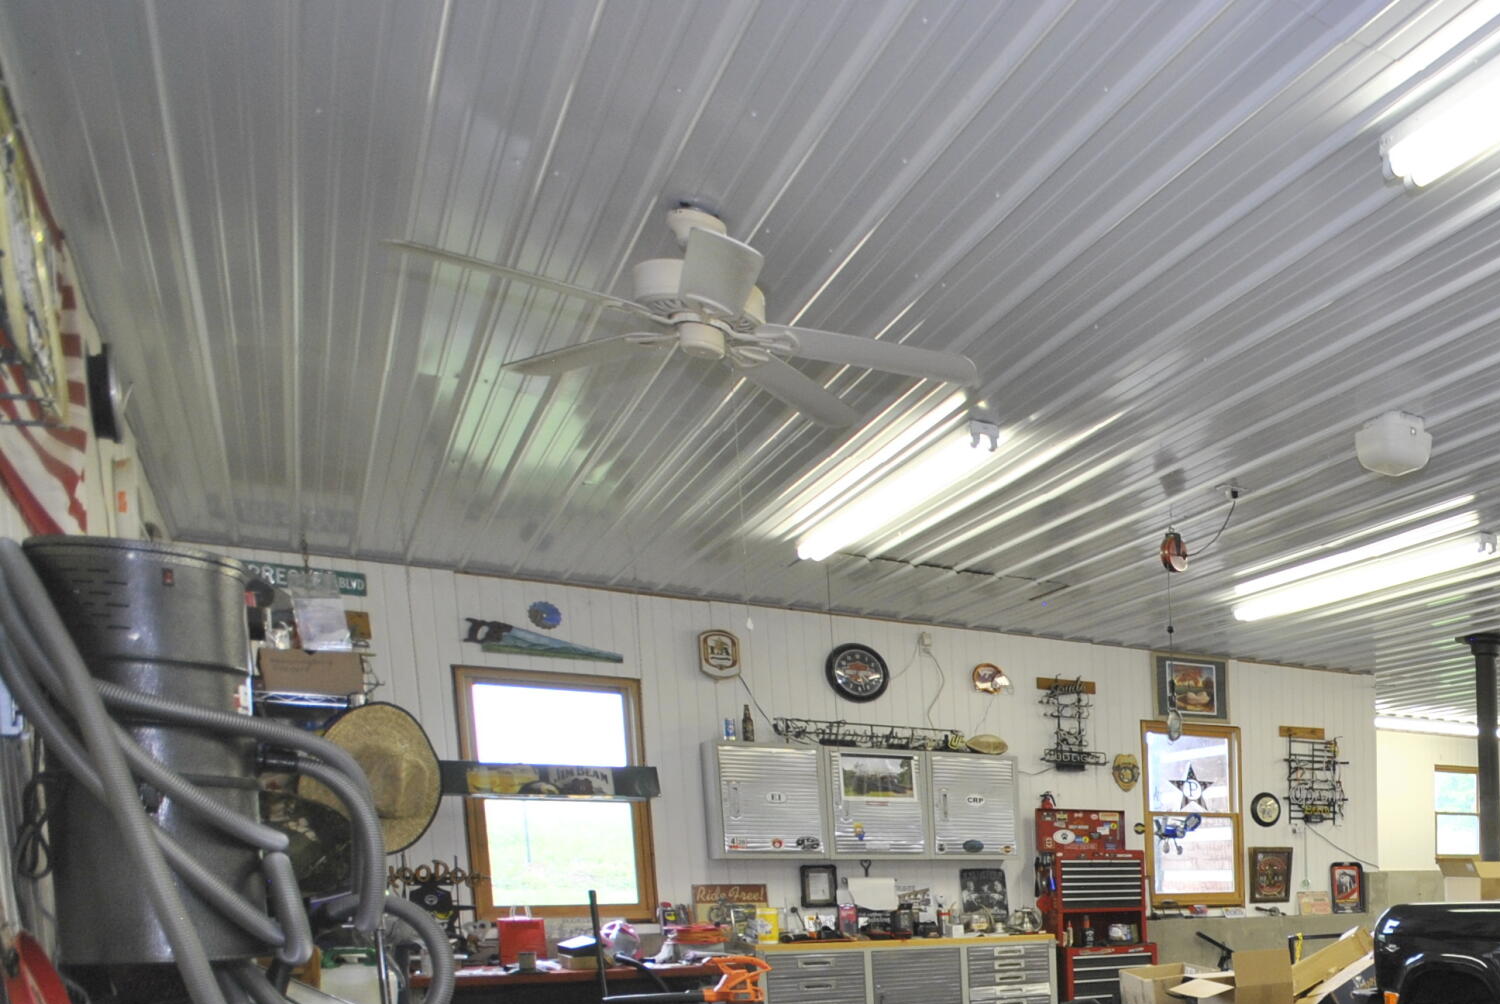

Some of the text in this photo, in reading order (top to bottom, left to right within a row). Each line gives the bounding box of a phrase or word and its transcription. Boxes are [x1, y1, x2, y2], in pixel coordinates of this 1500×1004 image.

[339, 577, 365, 590] BLVD
[554, 766, 609, 784] JIM BEAM
[1187, 781, 1198, 797] P
[696, 886, 764, 901] Ride Free!
